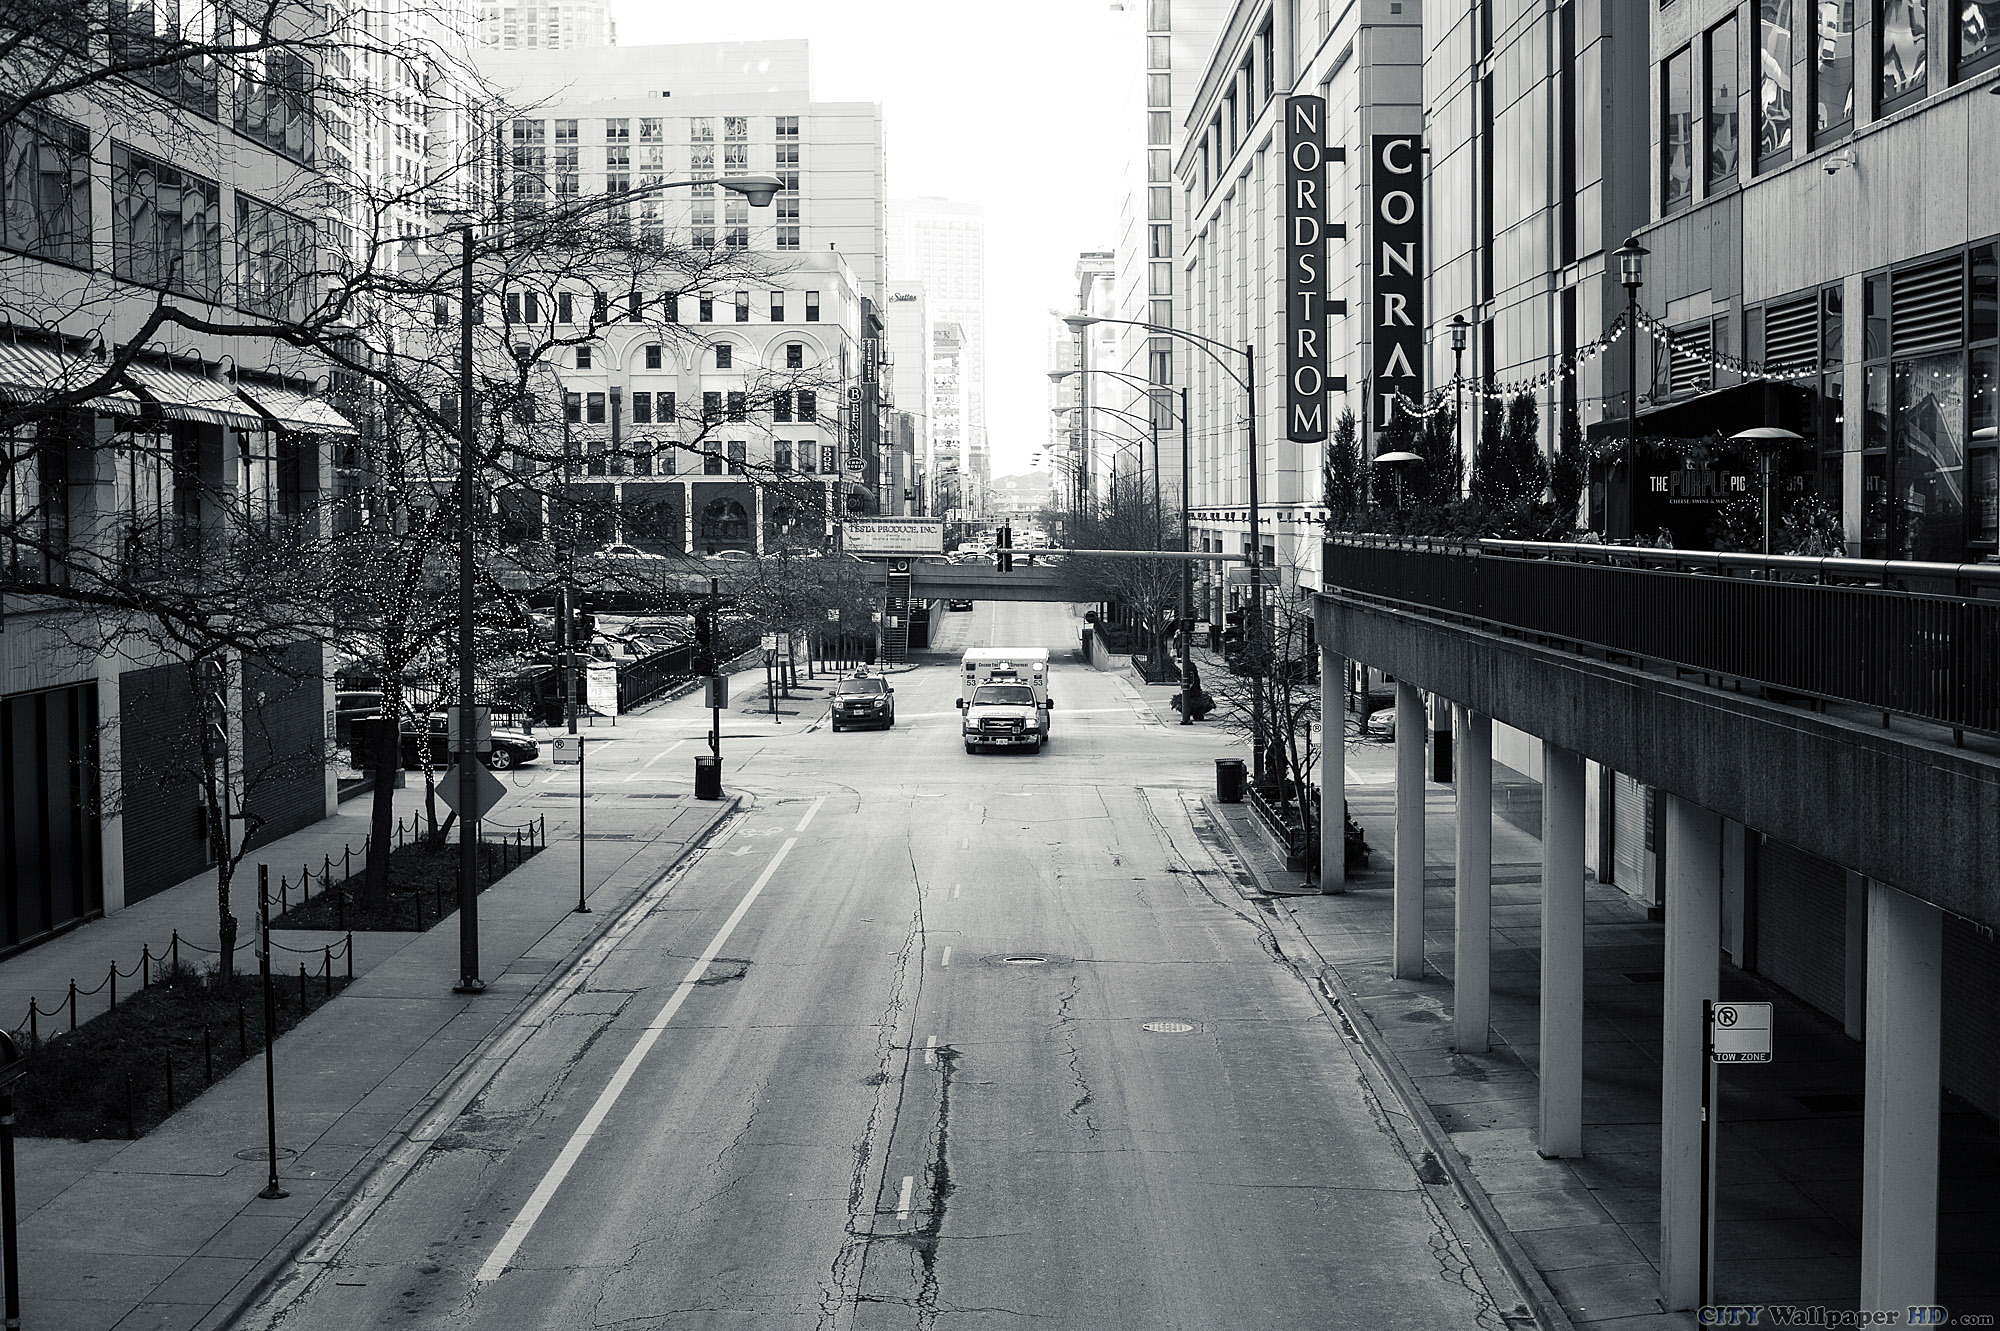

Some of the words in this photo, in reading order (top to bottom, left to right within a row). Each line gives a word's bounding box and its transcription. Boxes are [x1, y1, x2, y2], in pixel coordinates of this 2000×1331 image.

[1292, 103, 1322, 434] NORDSTROM
[823, 446, 833, 473] BOOKS
[1649, 475, 1669, 492] THE
[1670, 470, 1731, 497] PURPLE
[1730, 475, 1746, 492] PIG
[848, 524, 876, 533] TESTA
[966, 679, 976, 687] 53
[1033, 679, 1043, 687] 53
[1716, 1053, 1737, 1061] TOW
[1740, 1053, 1766, 1061] ZONE
